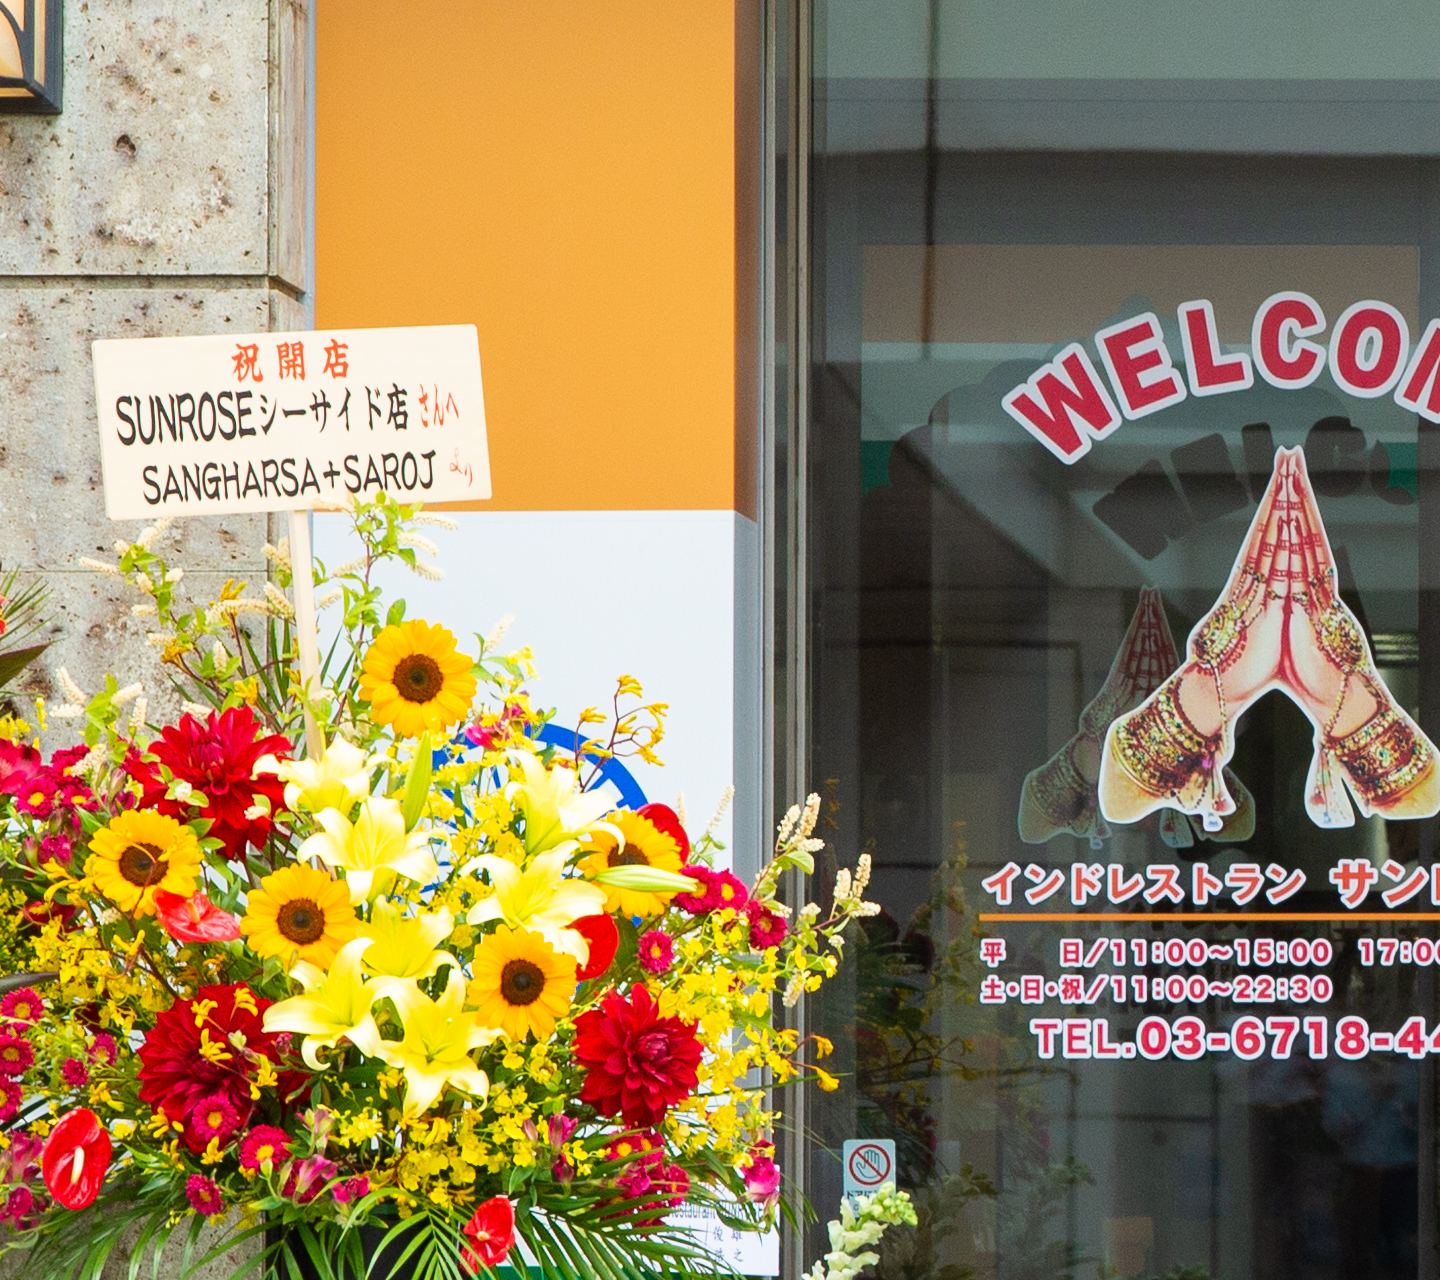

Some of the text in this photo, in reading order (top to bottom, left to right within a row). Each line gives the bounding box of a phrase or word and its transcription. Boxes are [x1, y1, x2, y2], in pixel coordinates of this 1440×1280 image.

[231, 338, 350, 382] 祝開店
[115, 383, 460, 446] SUNROSEシーサイド店 さんへ
[142, 449, 437, 505] SANGHARSA+SAROJ
[982, 862, 1304, 904] インドレストラン
